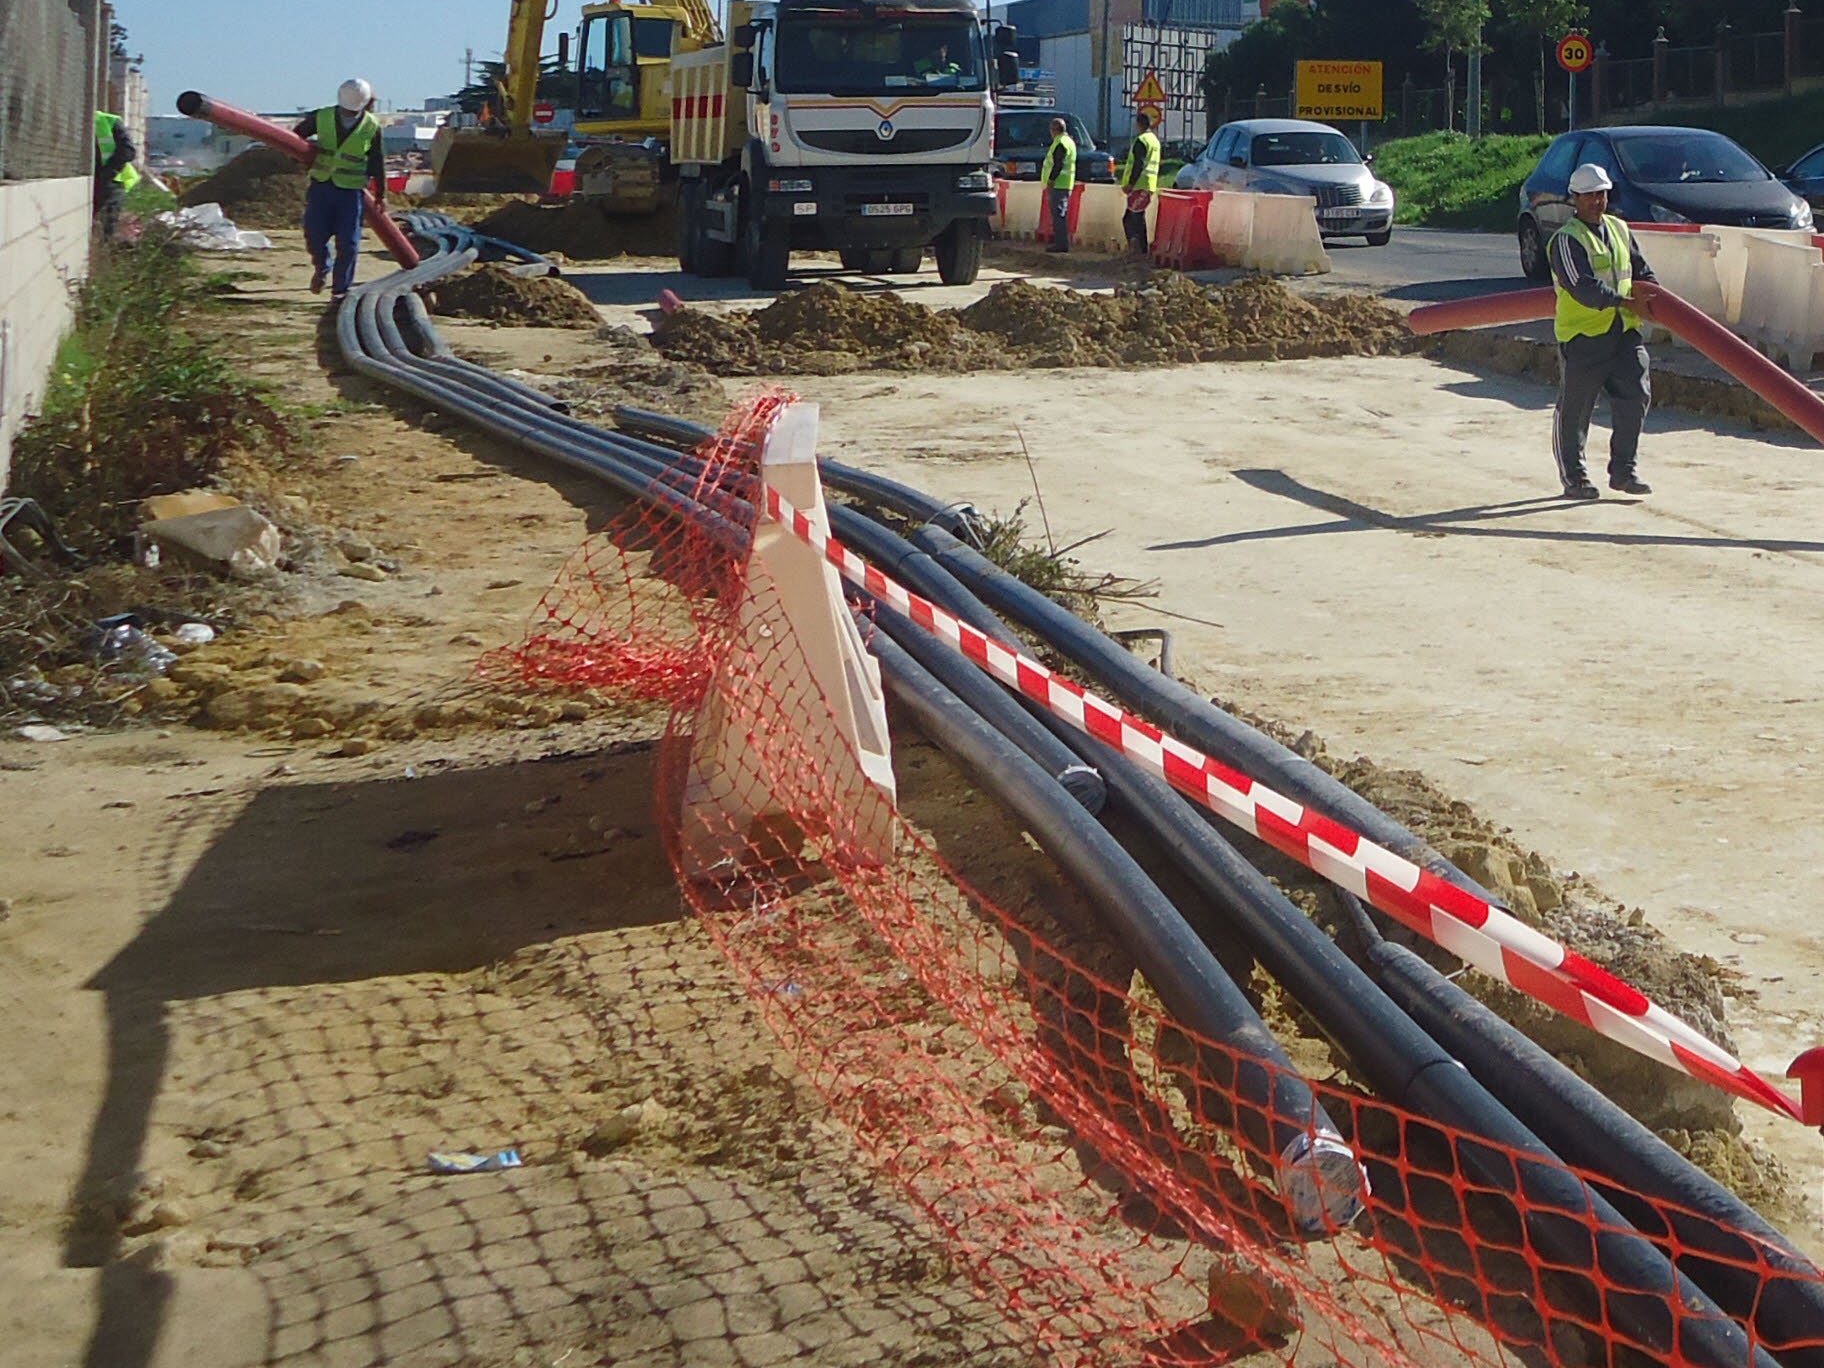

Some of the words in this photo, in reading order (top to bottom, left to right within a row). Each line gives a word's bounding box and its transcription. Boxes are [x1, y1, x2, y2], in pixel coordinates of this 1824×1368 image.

[1564, 47, 1584, 60] 30
[1317, 81, 1361, 93] DESVÍO
[1298, 106, 1379, 116] PROVISIONAL
[796, 204, 814, 212] SP
